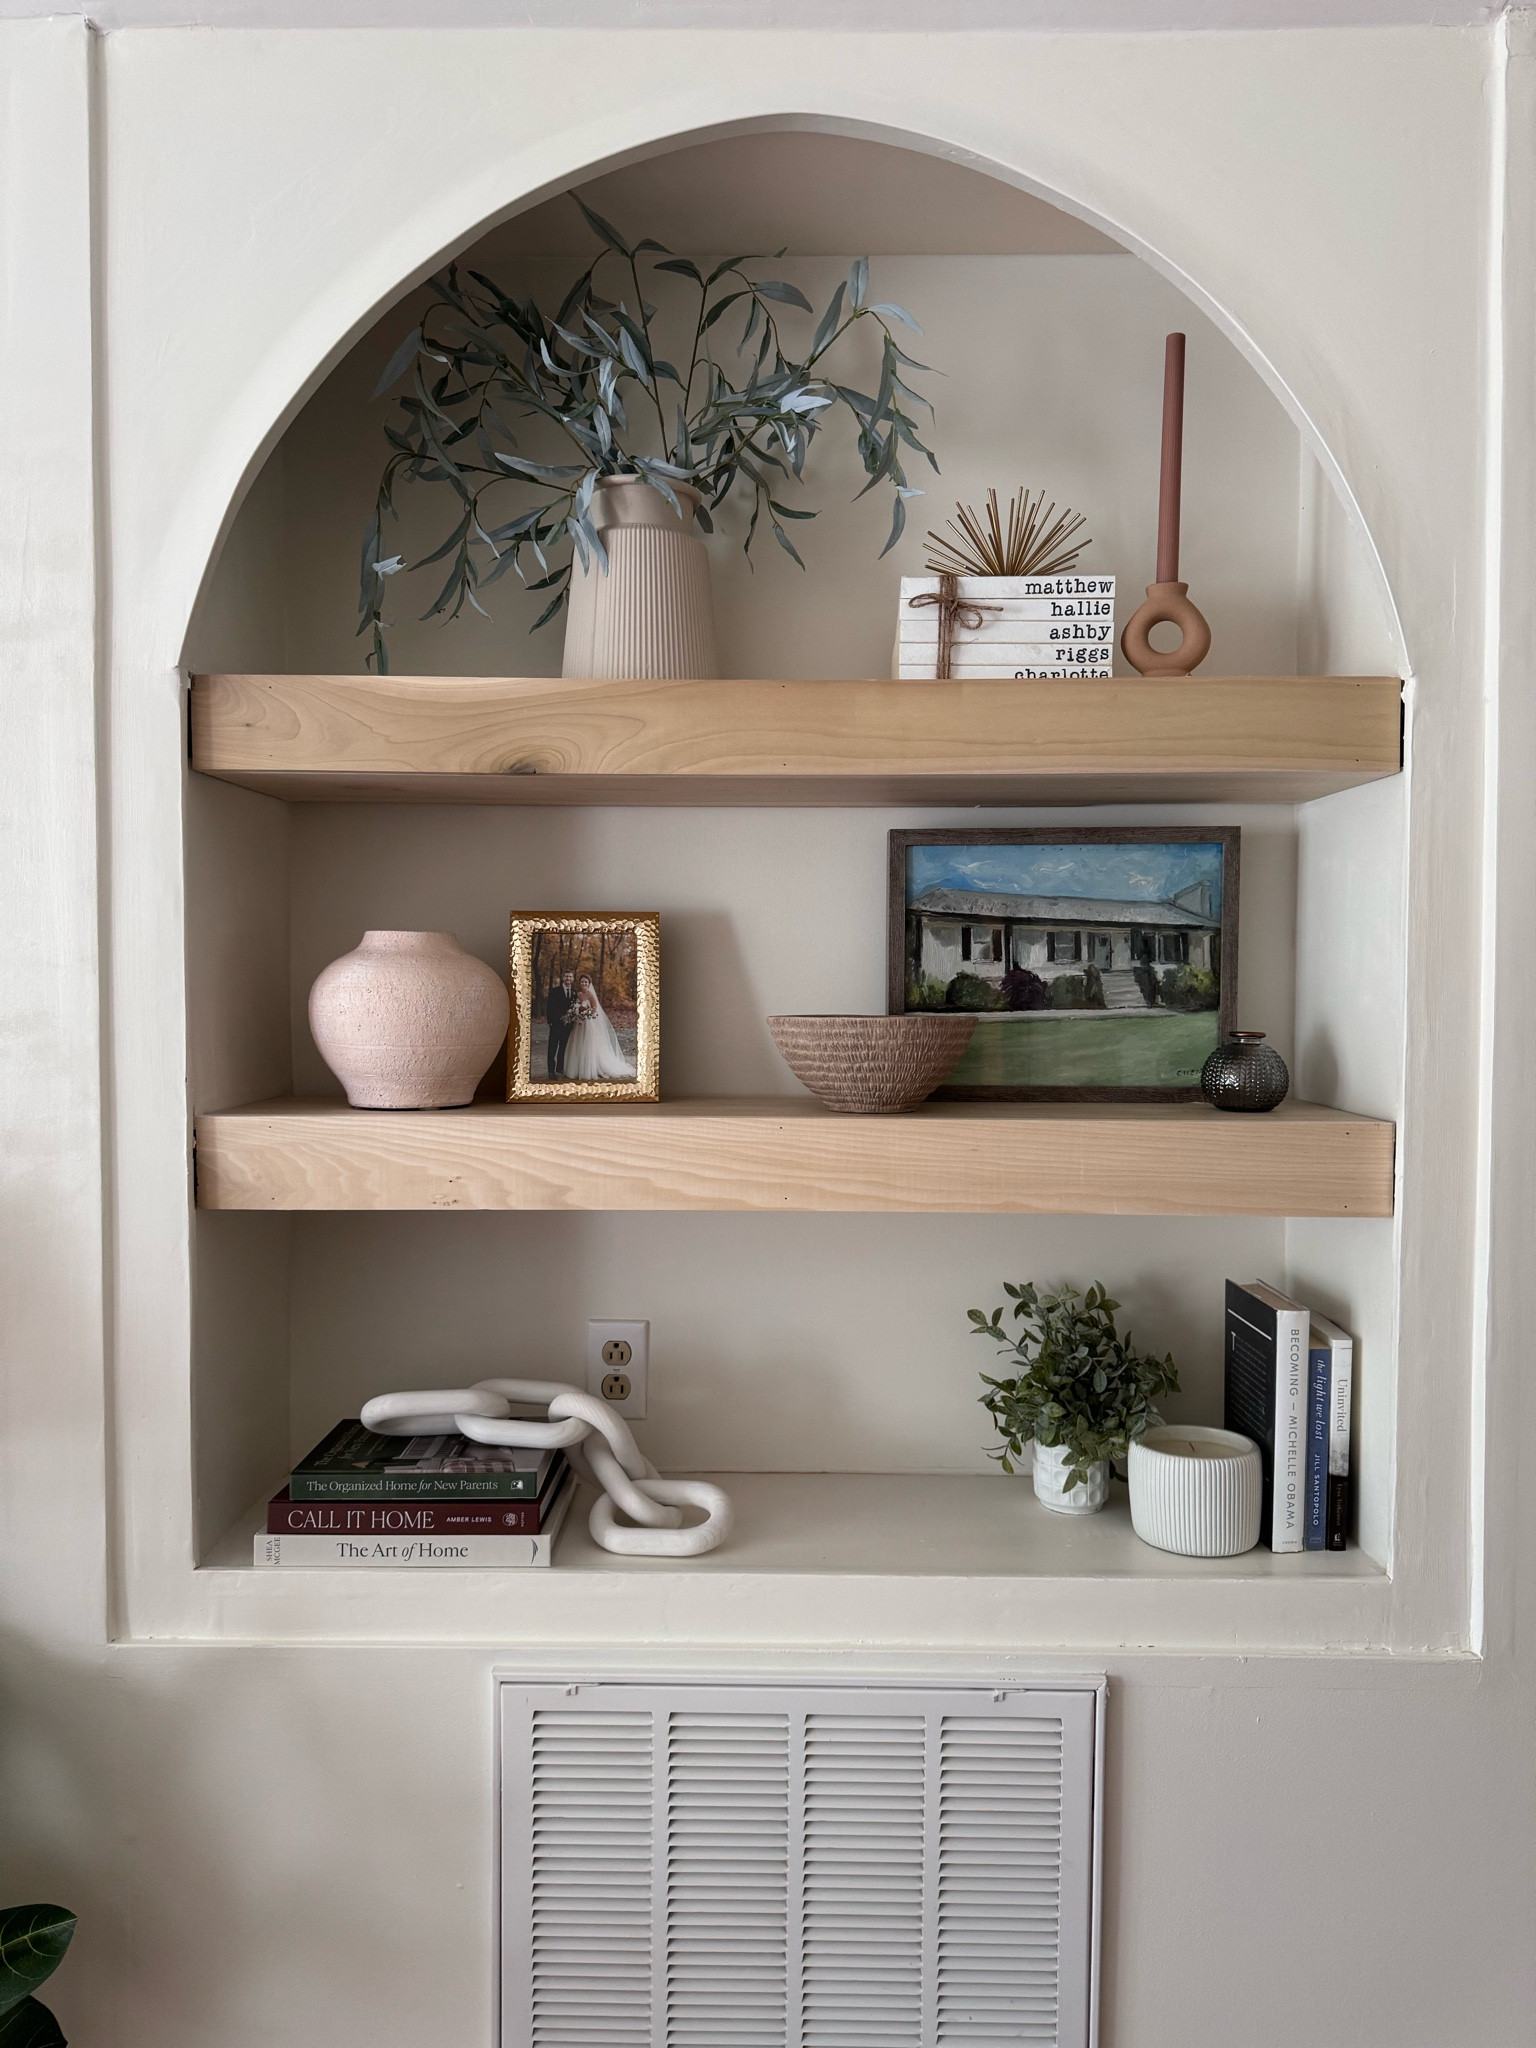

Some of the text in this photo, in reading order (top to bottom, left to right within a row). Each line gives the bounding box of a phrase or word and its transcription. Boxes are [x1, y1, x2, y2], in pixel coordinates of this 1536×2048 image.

[1024, 578, 1114, 595] matthew
[1050, 600, 1111, 617] hallie
[1049, 624, 1112, 641] ashby
[1055, 647, 1110, 664] riggs
[1014, 667, 1109, 679] charlotte
[1288, 1328, 1300, 1397] BECOMING
[1313, 1359, 1327, 1440] the light we lost
[1336, 1379, 1348, 1433] Uninvited
[1286, 1415, 1298, 1477] MICHELLE
[306, 1479, 499, 1493] The Organized Home for New Parents
[1285, 1483, 1296, 1529] OBAMA
[1312, 1474, 1321, 1526] SANTOPOLO
[287, 1510, 435, 1529] CALL IT HOME
[265, 1540, 273, 1562] SHEA
[273, 1536, 281, 1565] MCGEE
[336, 1542, 469, 1562] The Art of Home
